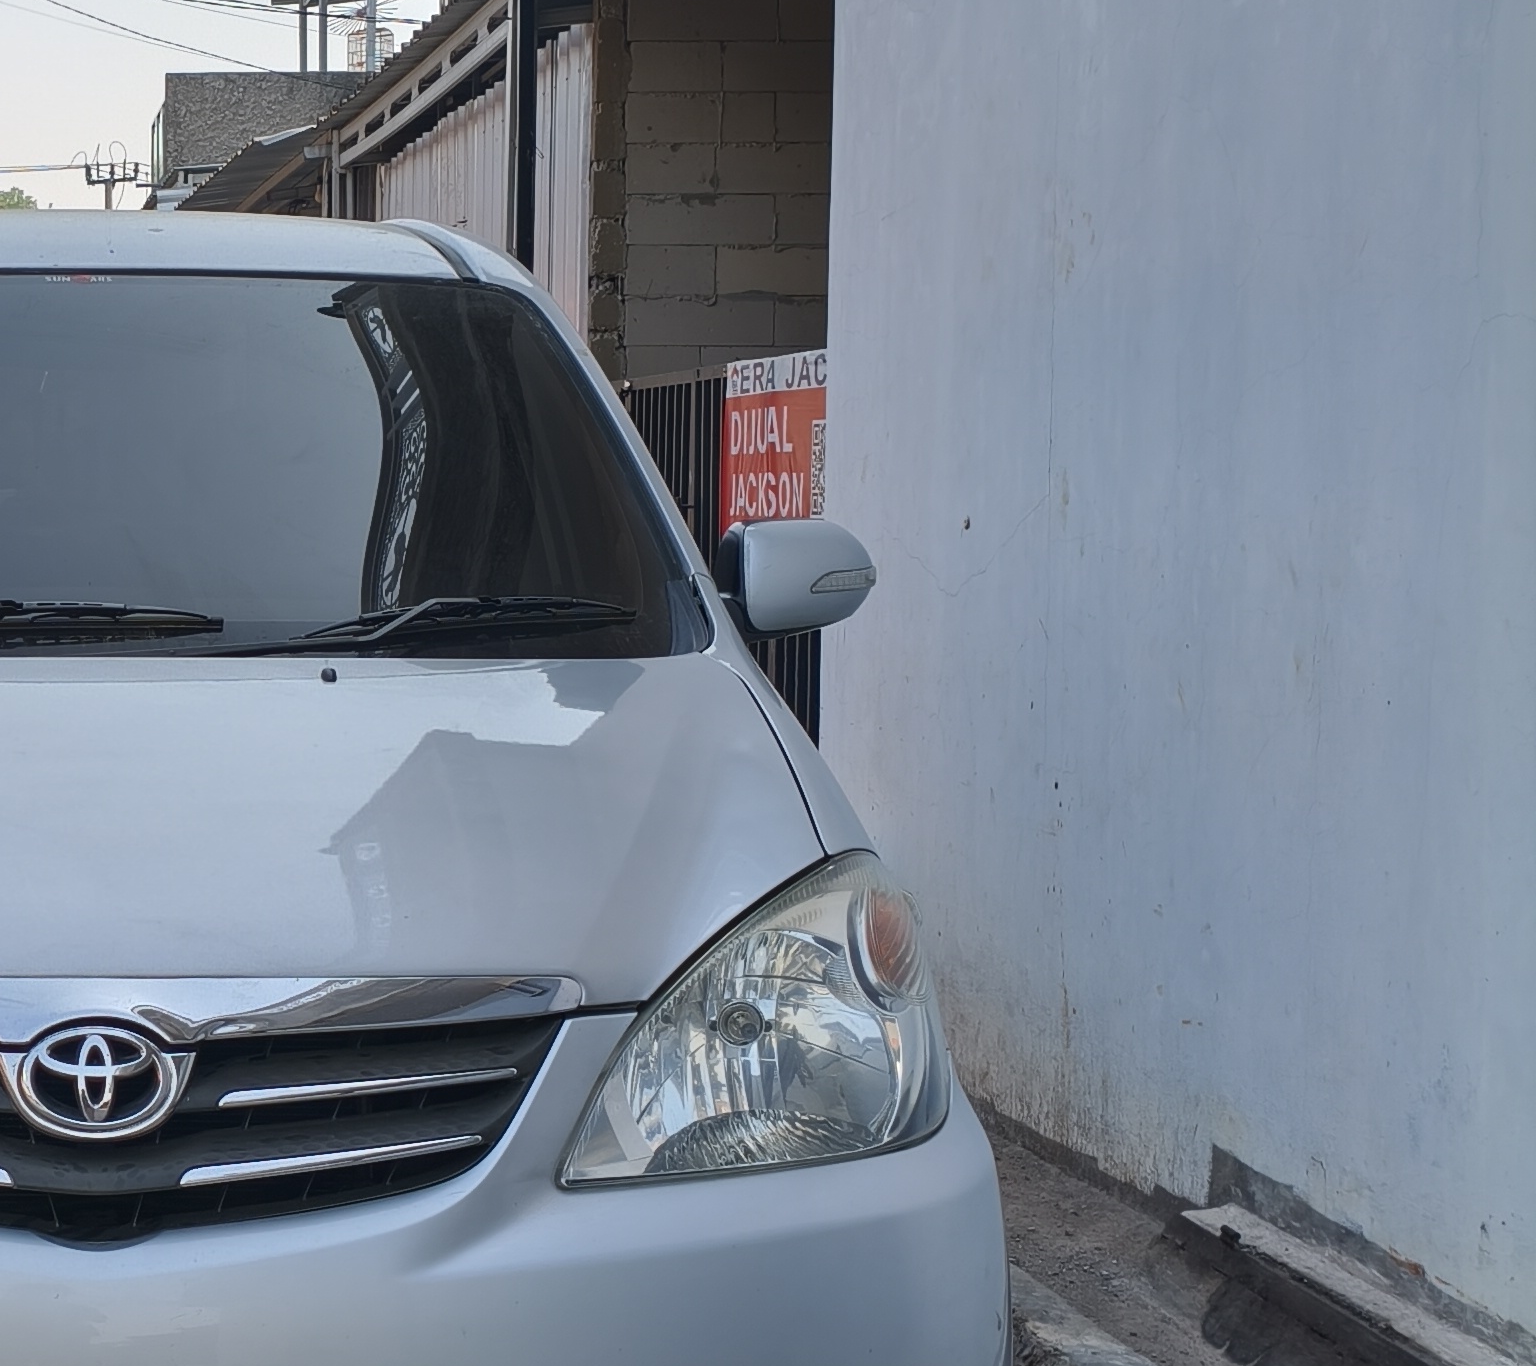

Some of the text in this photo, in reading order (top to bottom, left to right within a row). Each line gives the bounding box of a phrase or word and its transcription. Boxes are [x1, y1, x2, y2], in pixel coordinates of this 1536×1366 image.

[740, 360, 775, 393] ERA
[731, 406, 792, 455] DIJUAL
[730, 472, 804, 517] JACKSON
